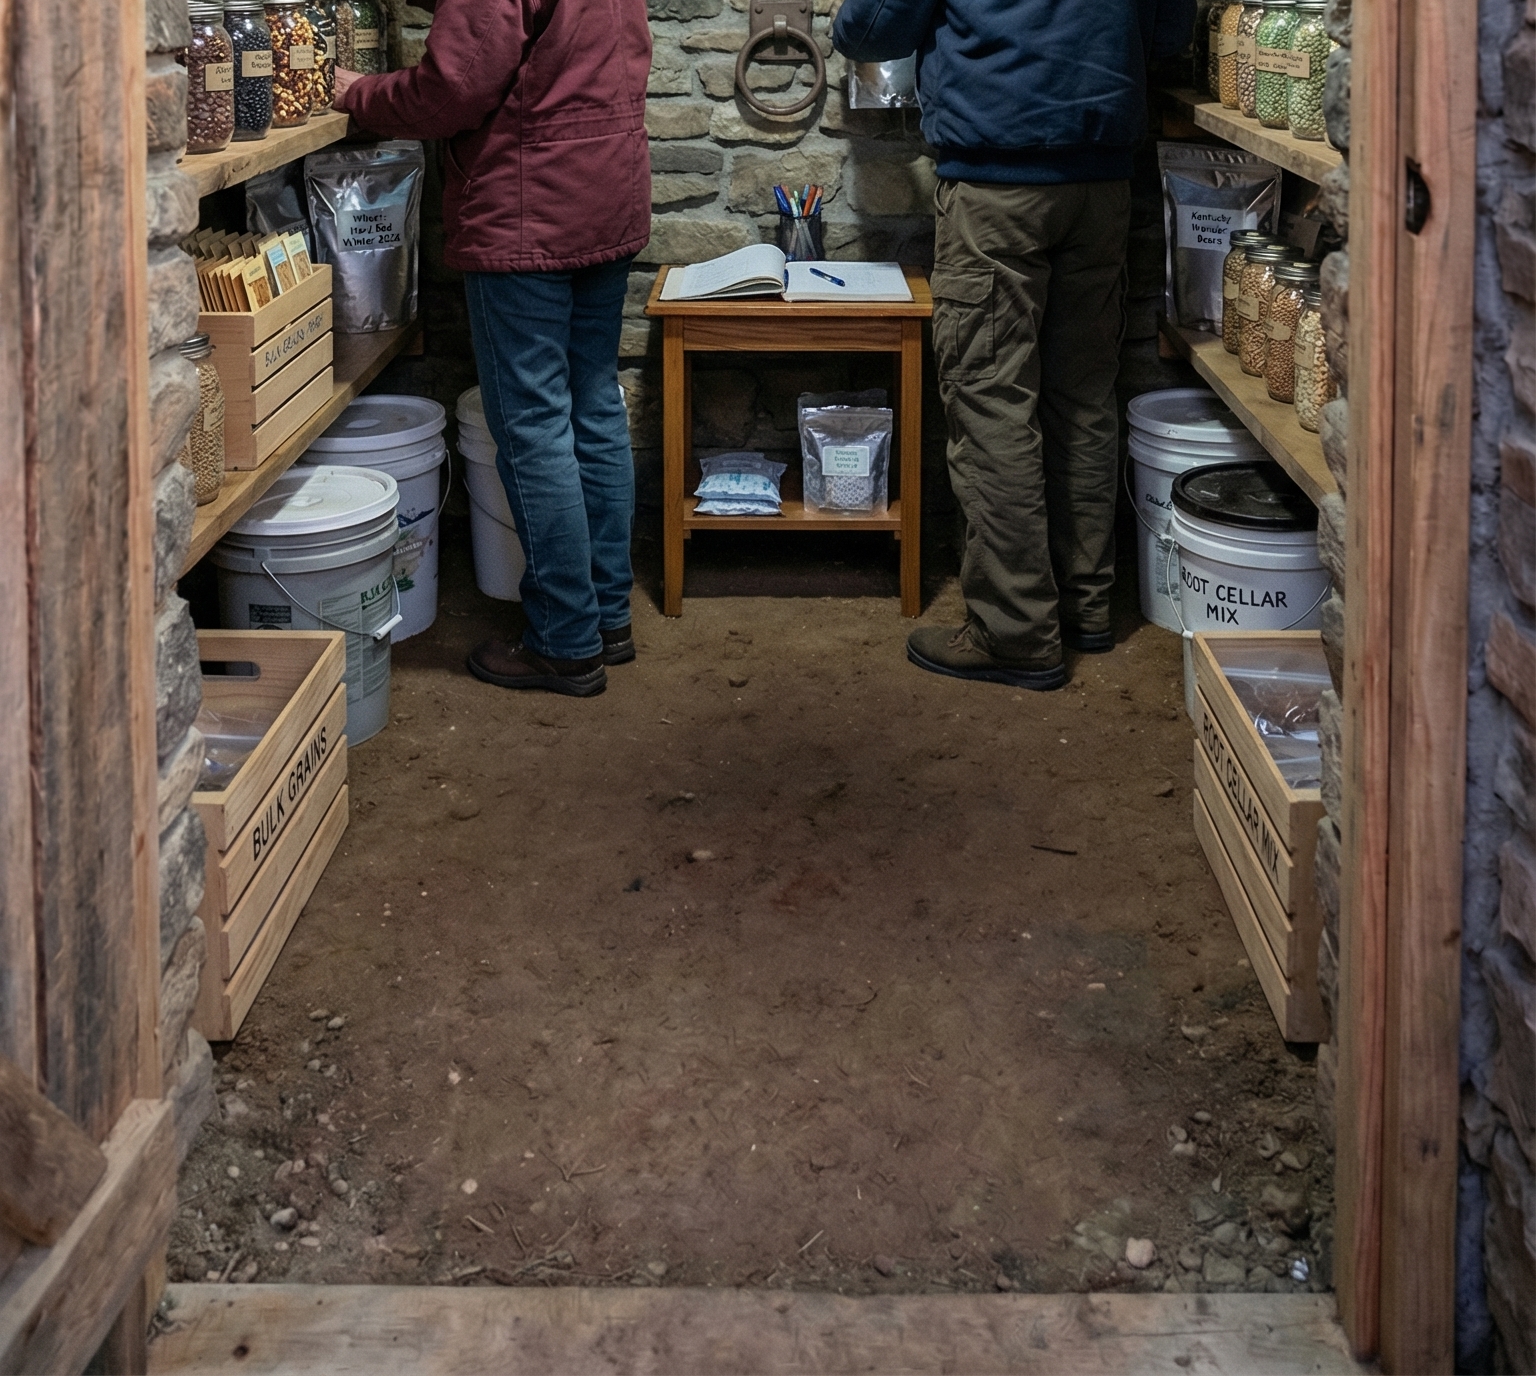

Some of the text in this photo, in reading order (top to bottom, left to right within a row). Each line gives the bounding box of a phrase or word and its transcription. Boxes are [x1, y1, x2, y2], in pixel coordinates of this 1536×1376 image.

[1206, 603, 1239, 626] MIX
[1215, 584, 1288, 608] CELLAR
[252, 726, 327, 862] BULK GRAINS
[1203, 712, 1280, 884] ROOT CELLAR MIX
